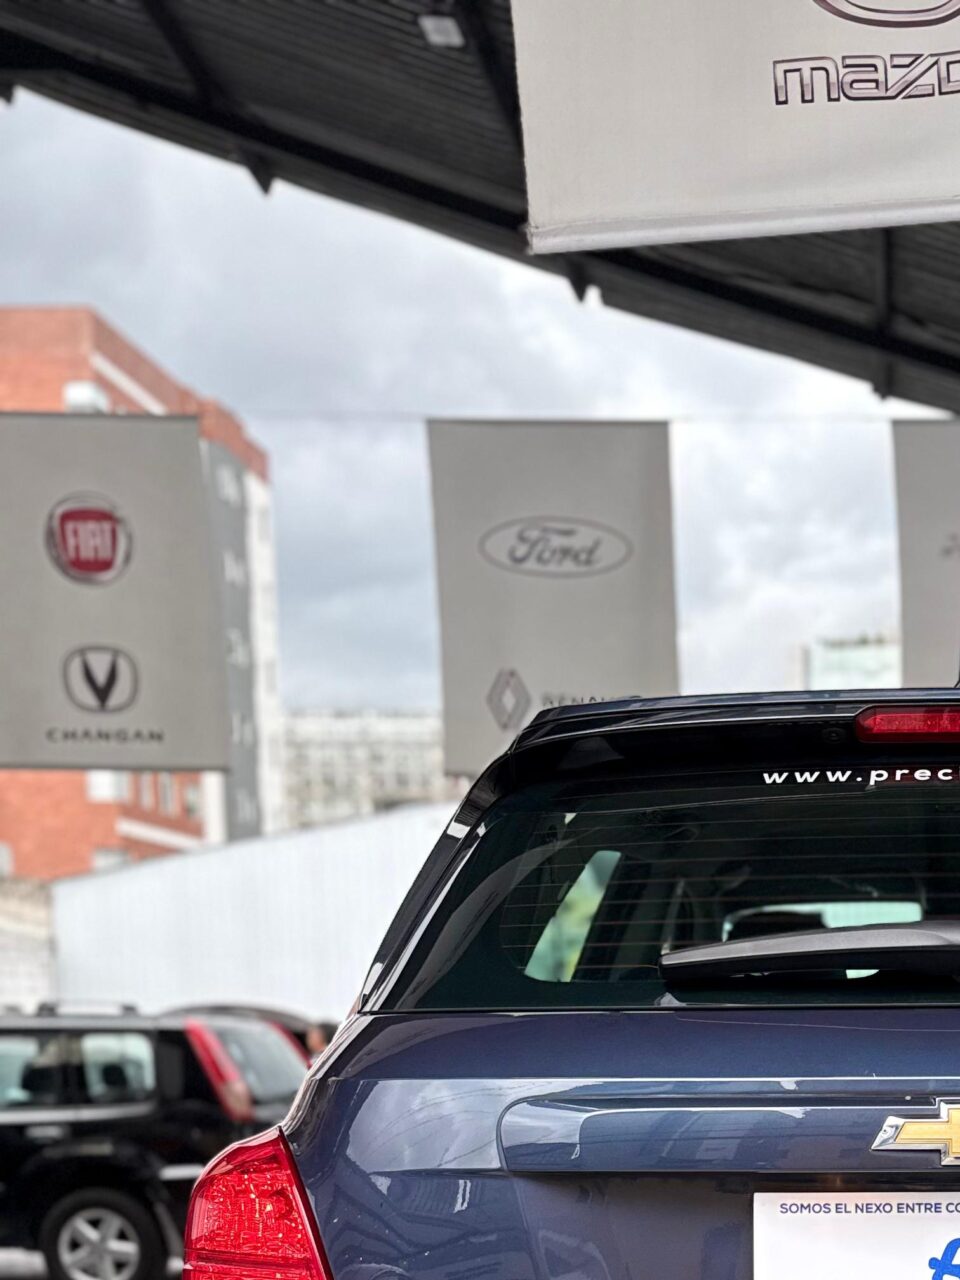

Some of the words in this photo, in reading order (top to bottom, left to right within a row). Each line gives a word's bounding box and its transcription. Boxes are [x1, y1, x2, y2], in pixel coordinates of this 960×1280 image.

[63, 518, 117, 562] FIAT
[507, 524, 602, 567] Ford
[46, 727, 164, 743] CHANGAN
[779, 1203, 832, 1214] SOMOS
[835, 1203, 851, 1213] EL
[855, 1203, 893, 1213] NEXO
[897, 1203, 942, 1213] ENTRE
